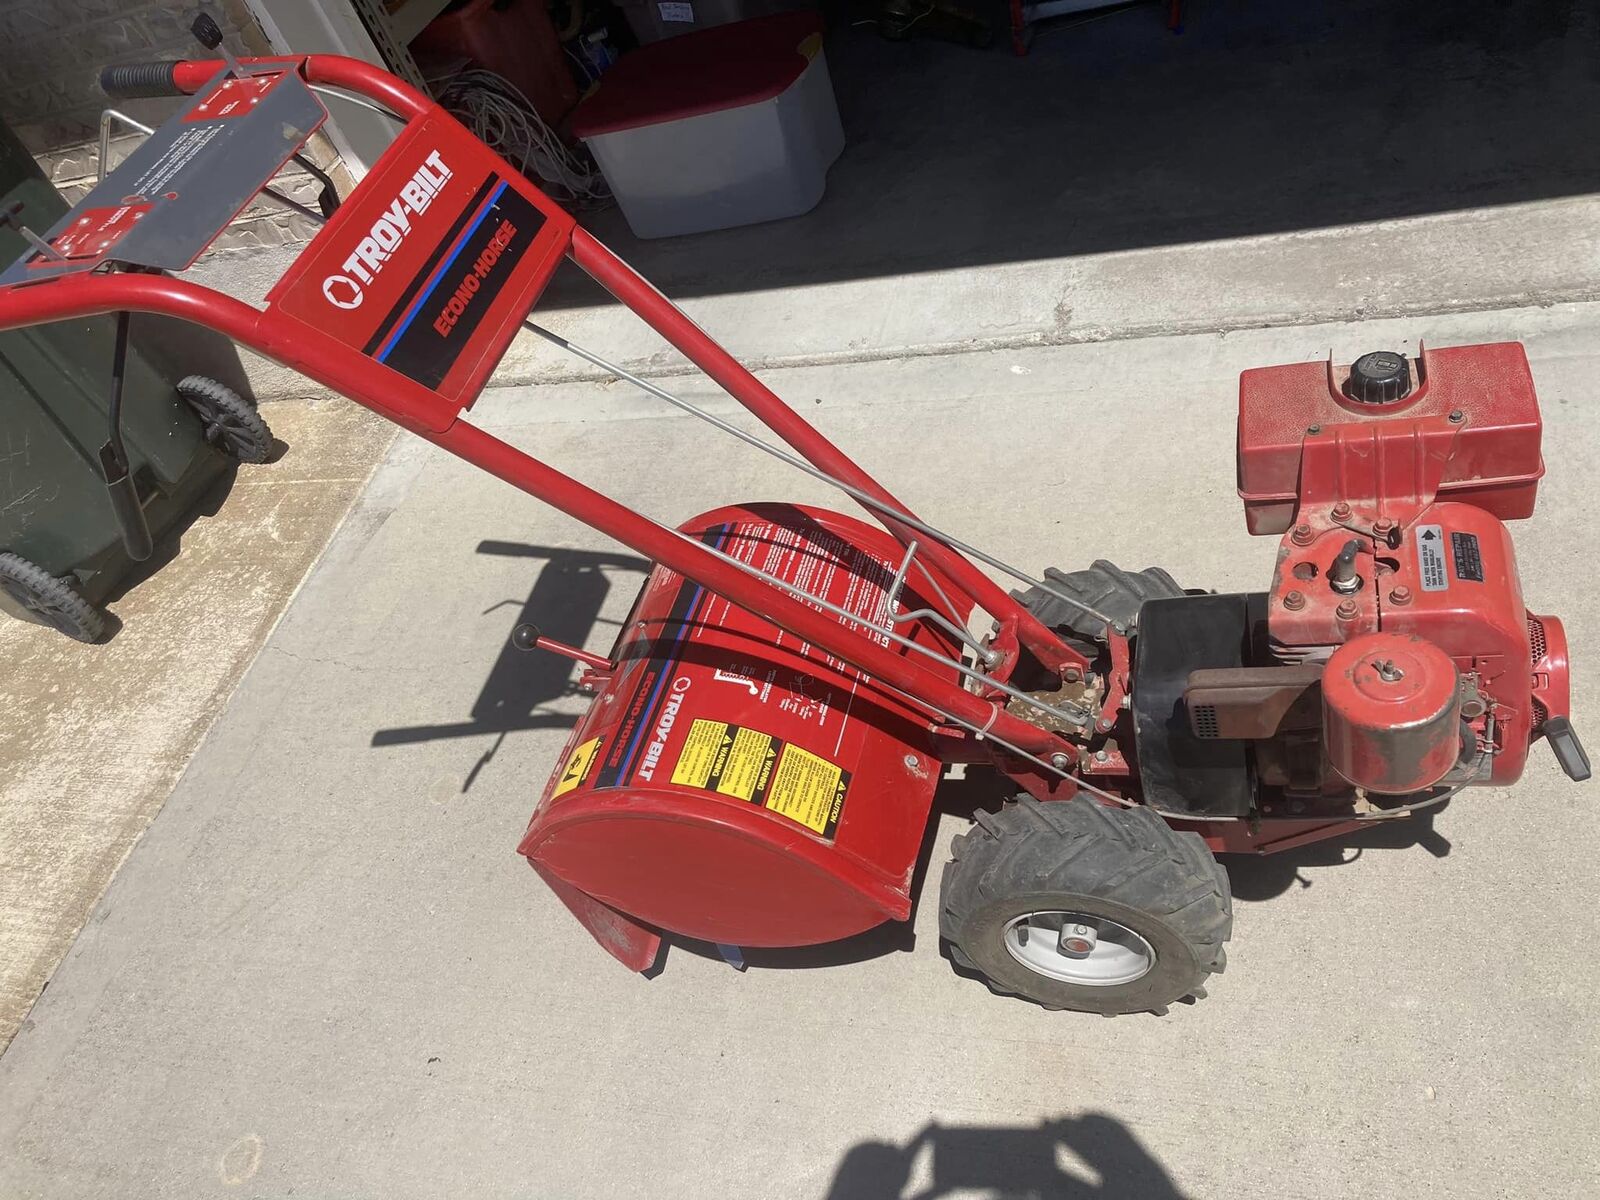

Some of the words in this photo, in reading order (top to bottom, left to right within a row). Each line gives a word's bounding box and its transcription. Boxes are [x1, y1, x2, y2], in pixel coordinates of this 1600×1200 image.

[342, 149, 453, 286] TROY-BILT
[433, 219, 518, 338] ECONO-HORSE
[609, 671, 656, 767] ECONO-HORSE
[639, 693, 685, 782] TROY-BILT
[711, 745, 729, 777] WARNING
[756, 758, 773, 791] WARNING
[829, 792, 843, 823] CAUTION
